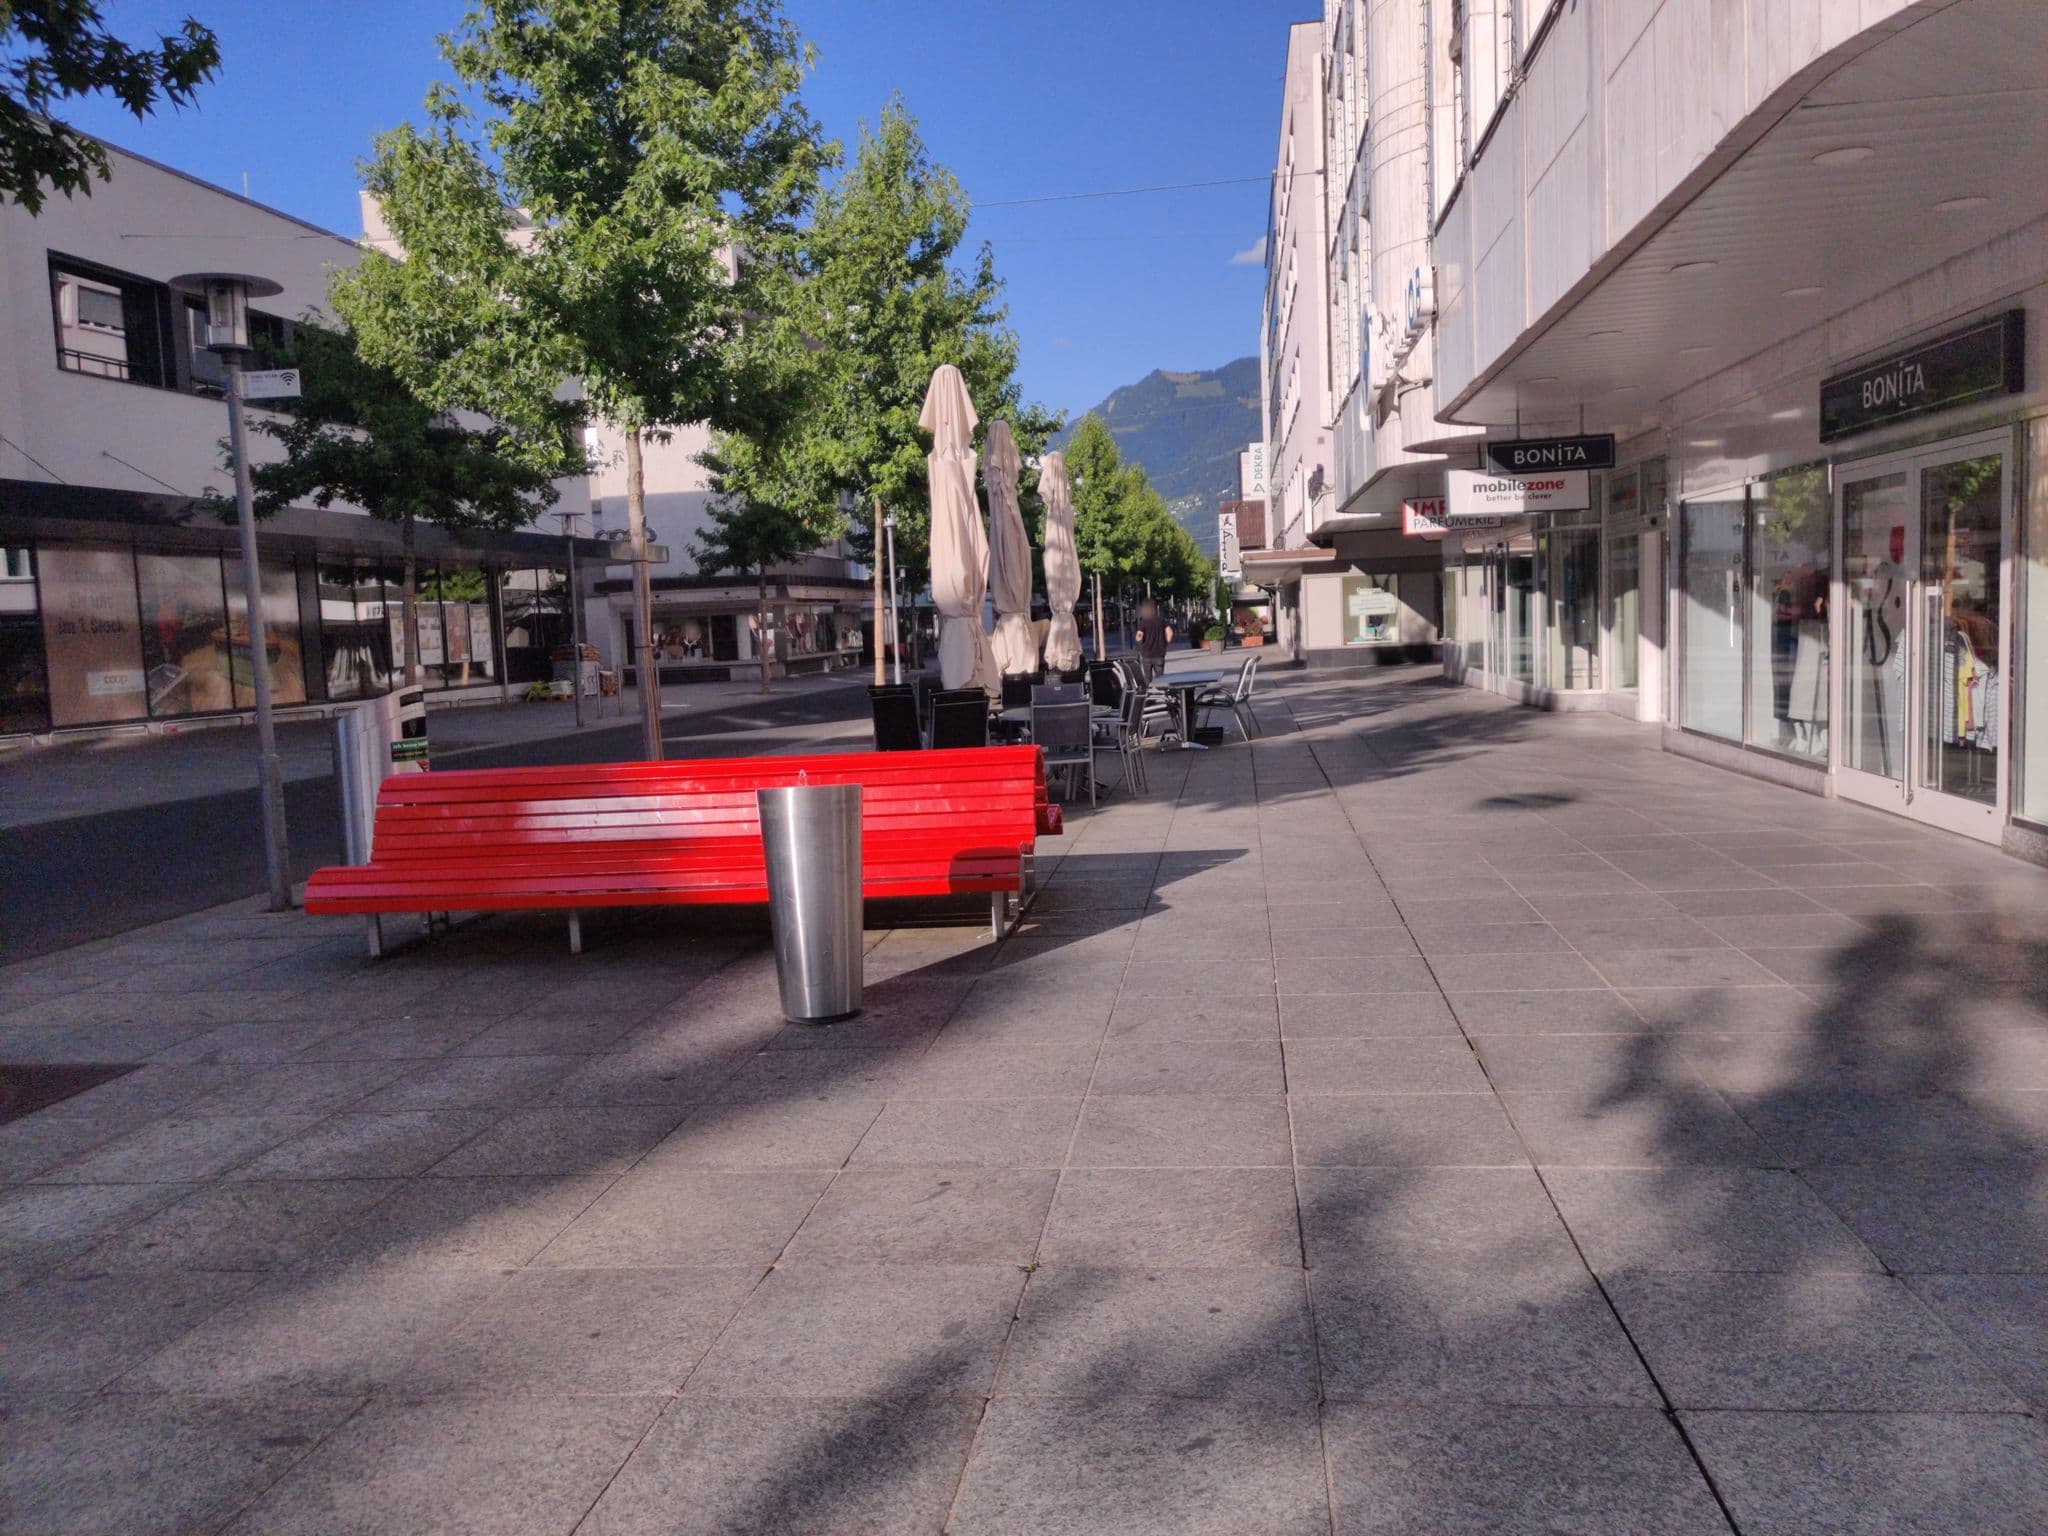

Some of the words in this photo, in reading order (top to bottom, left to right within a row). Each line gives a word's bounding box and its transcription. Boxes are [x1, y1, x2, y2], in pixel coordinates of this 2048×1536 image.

[1863, 361, 1925, 409] BONITA
[1253, 447, 1263, 480] DEKRA
[1514, 444, 1587, 466] BONITA
[1473, 479, 1565, 493] mobilezone
[1486, 493, 1511, 502] better
